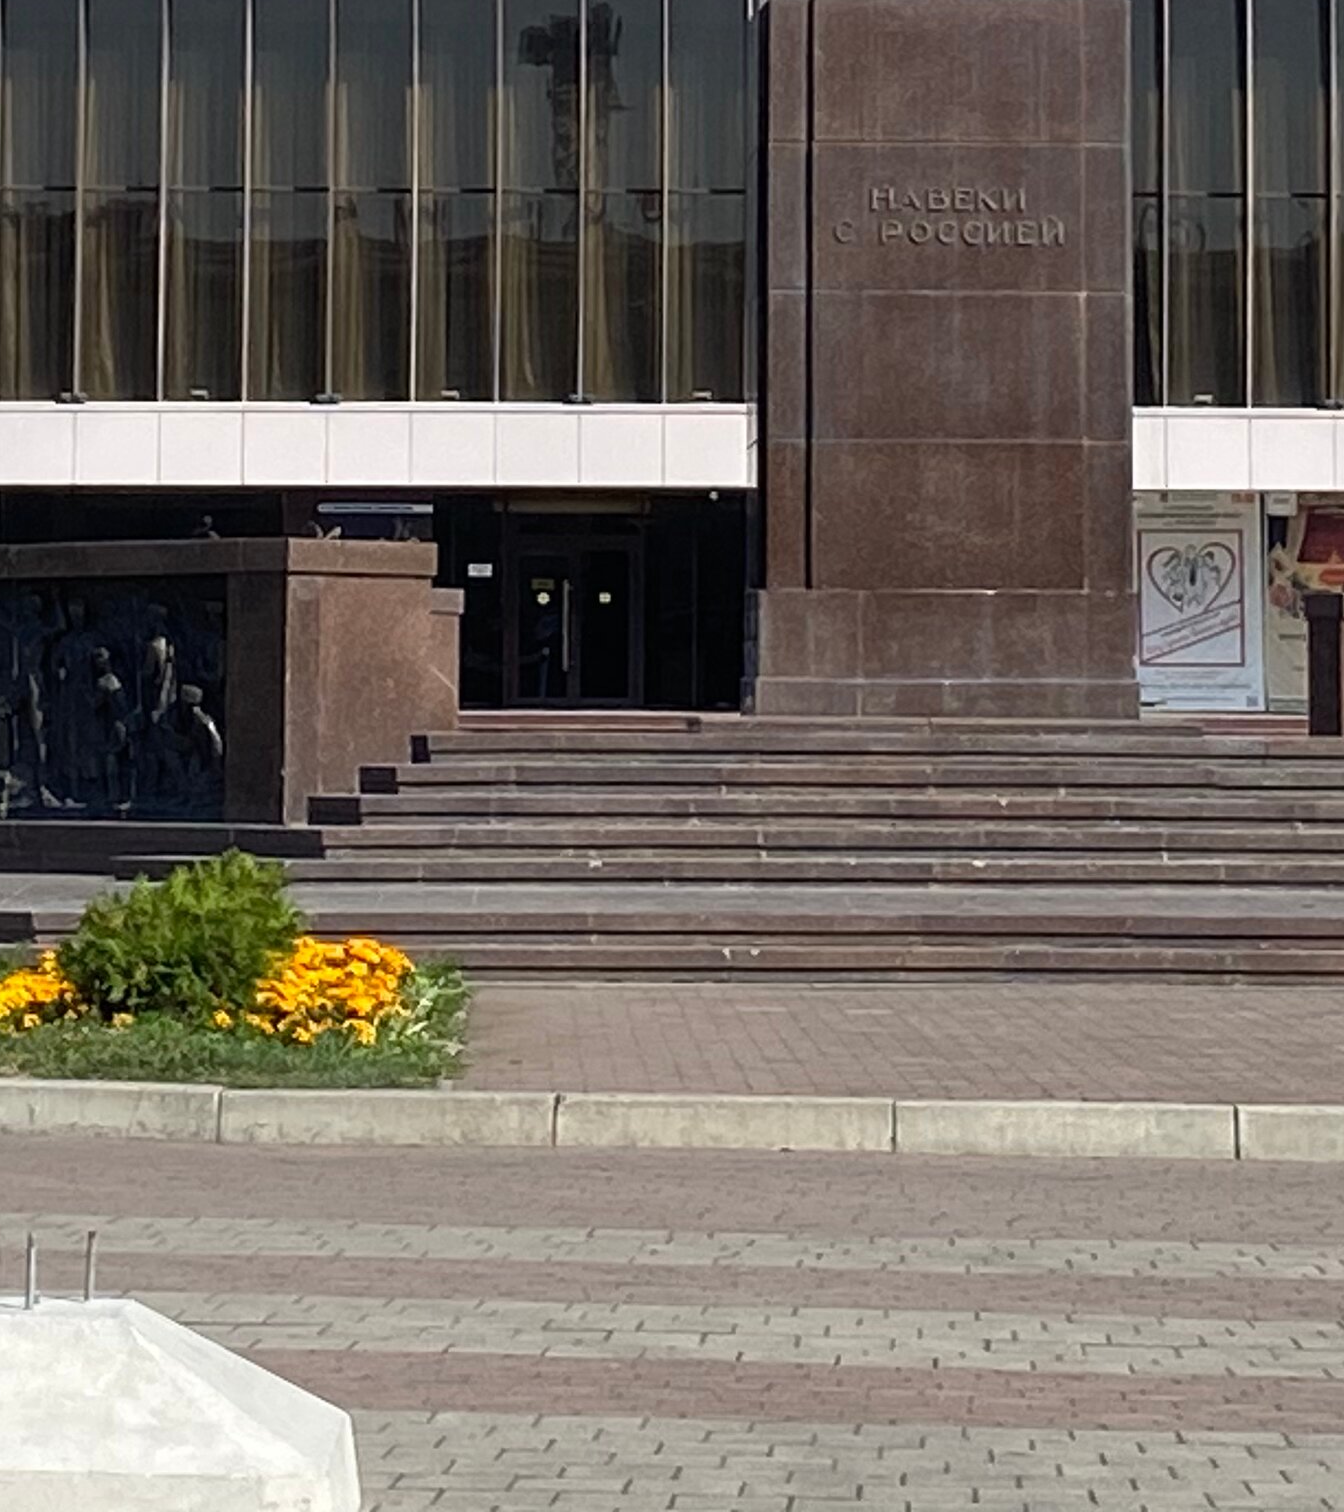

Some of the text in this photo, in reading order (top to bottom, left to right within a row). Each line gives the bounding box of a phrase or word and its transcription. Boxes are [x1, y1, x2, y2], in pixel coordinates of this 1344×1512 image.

[868, 186, 1027, 213] НАВЕКИ
[833, 214, 1068, 247] С РОССИЕЙ
